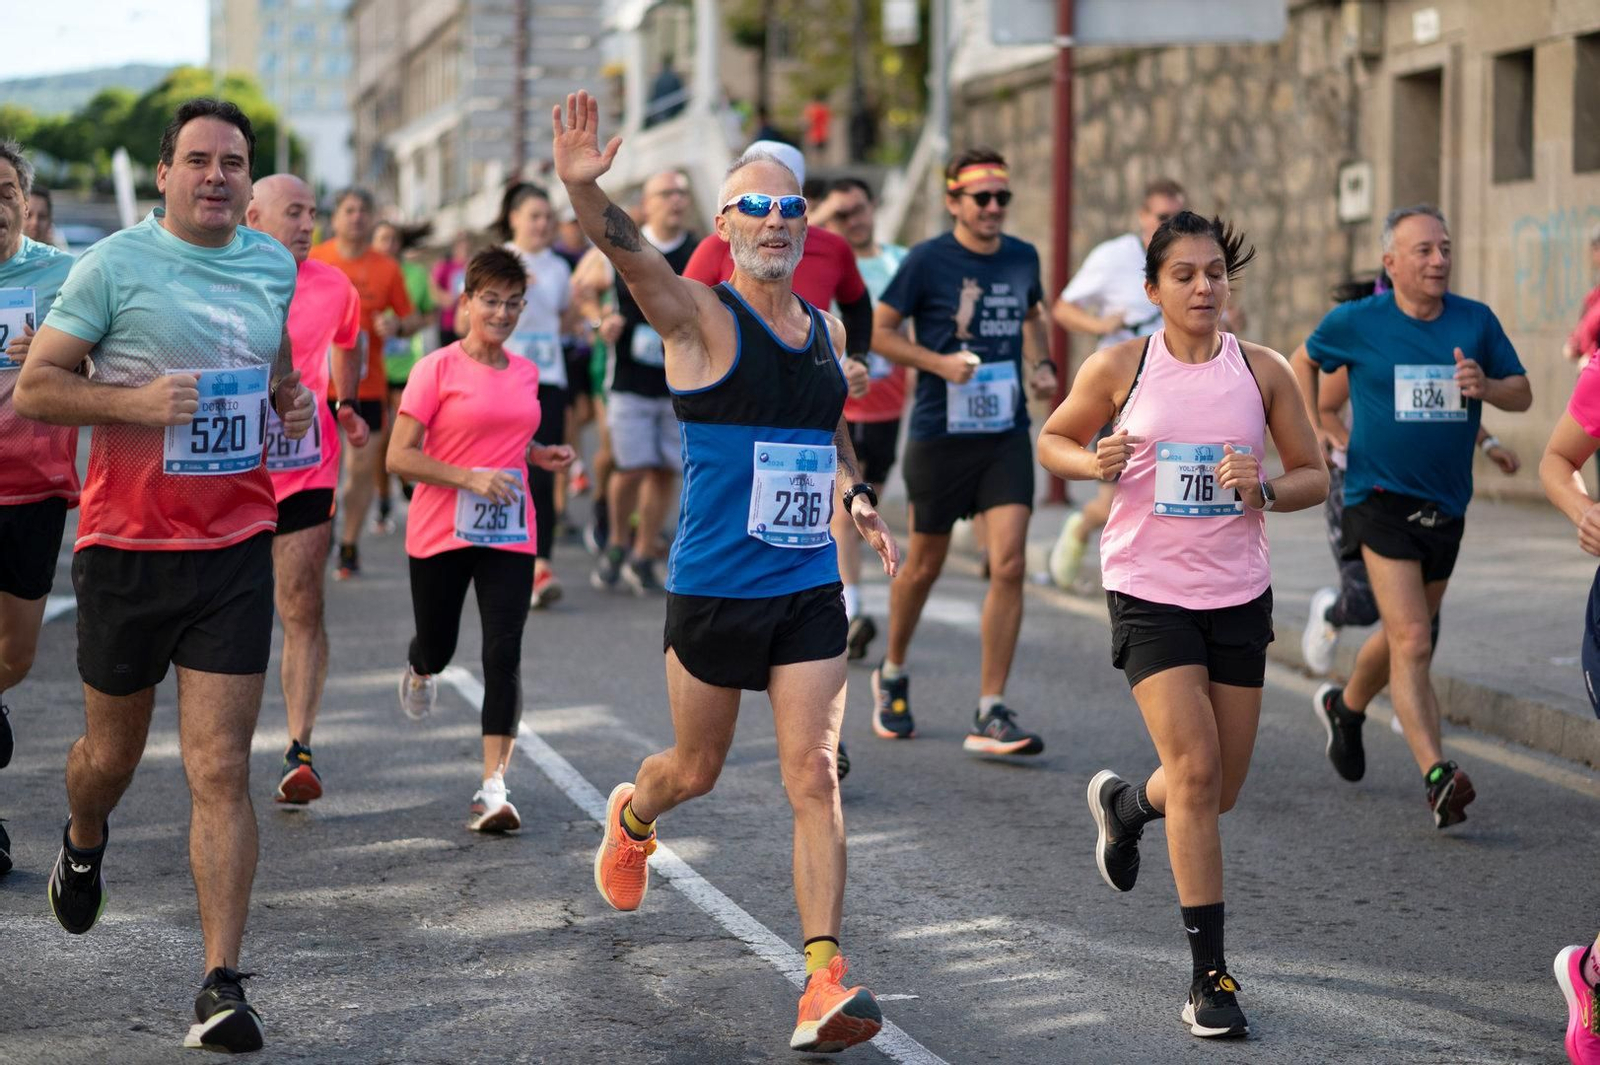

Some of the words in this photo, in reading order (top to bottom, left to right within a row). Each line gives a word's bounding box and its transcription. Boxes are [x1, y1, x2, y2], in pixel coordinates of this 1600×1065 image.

[1412, 388, 1445, 409] 824
[191, 415, 246, 454] 520
[788, 477, 815, 487] VIDAL
[1180, 474, 1214, 502] 716
[473, 503, 508, 530] 235
[773, 490, 822, 527] 236
